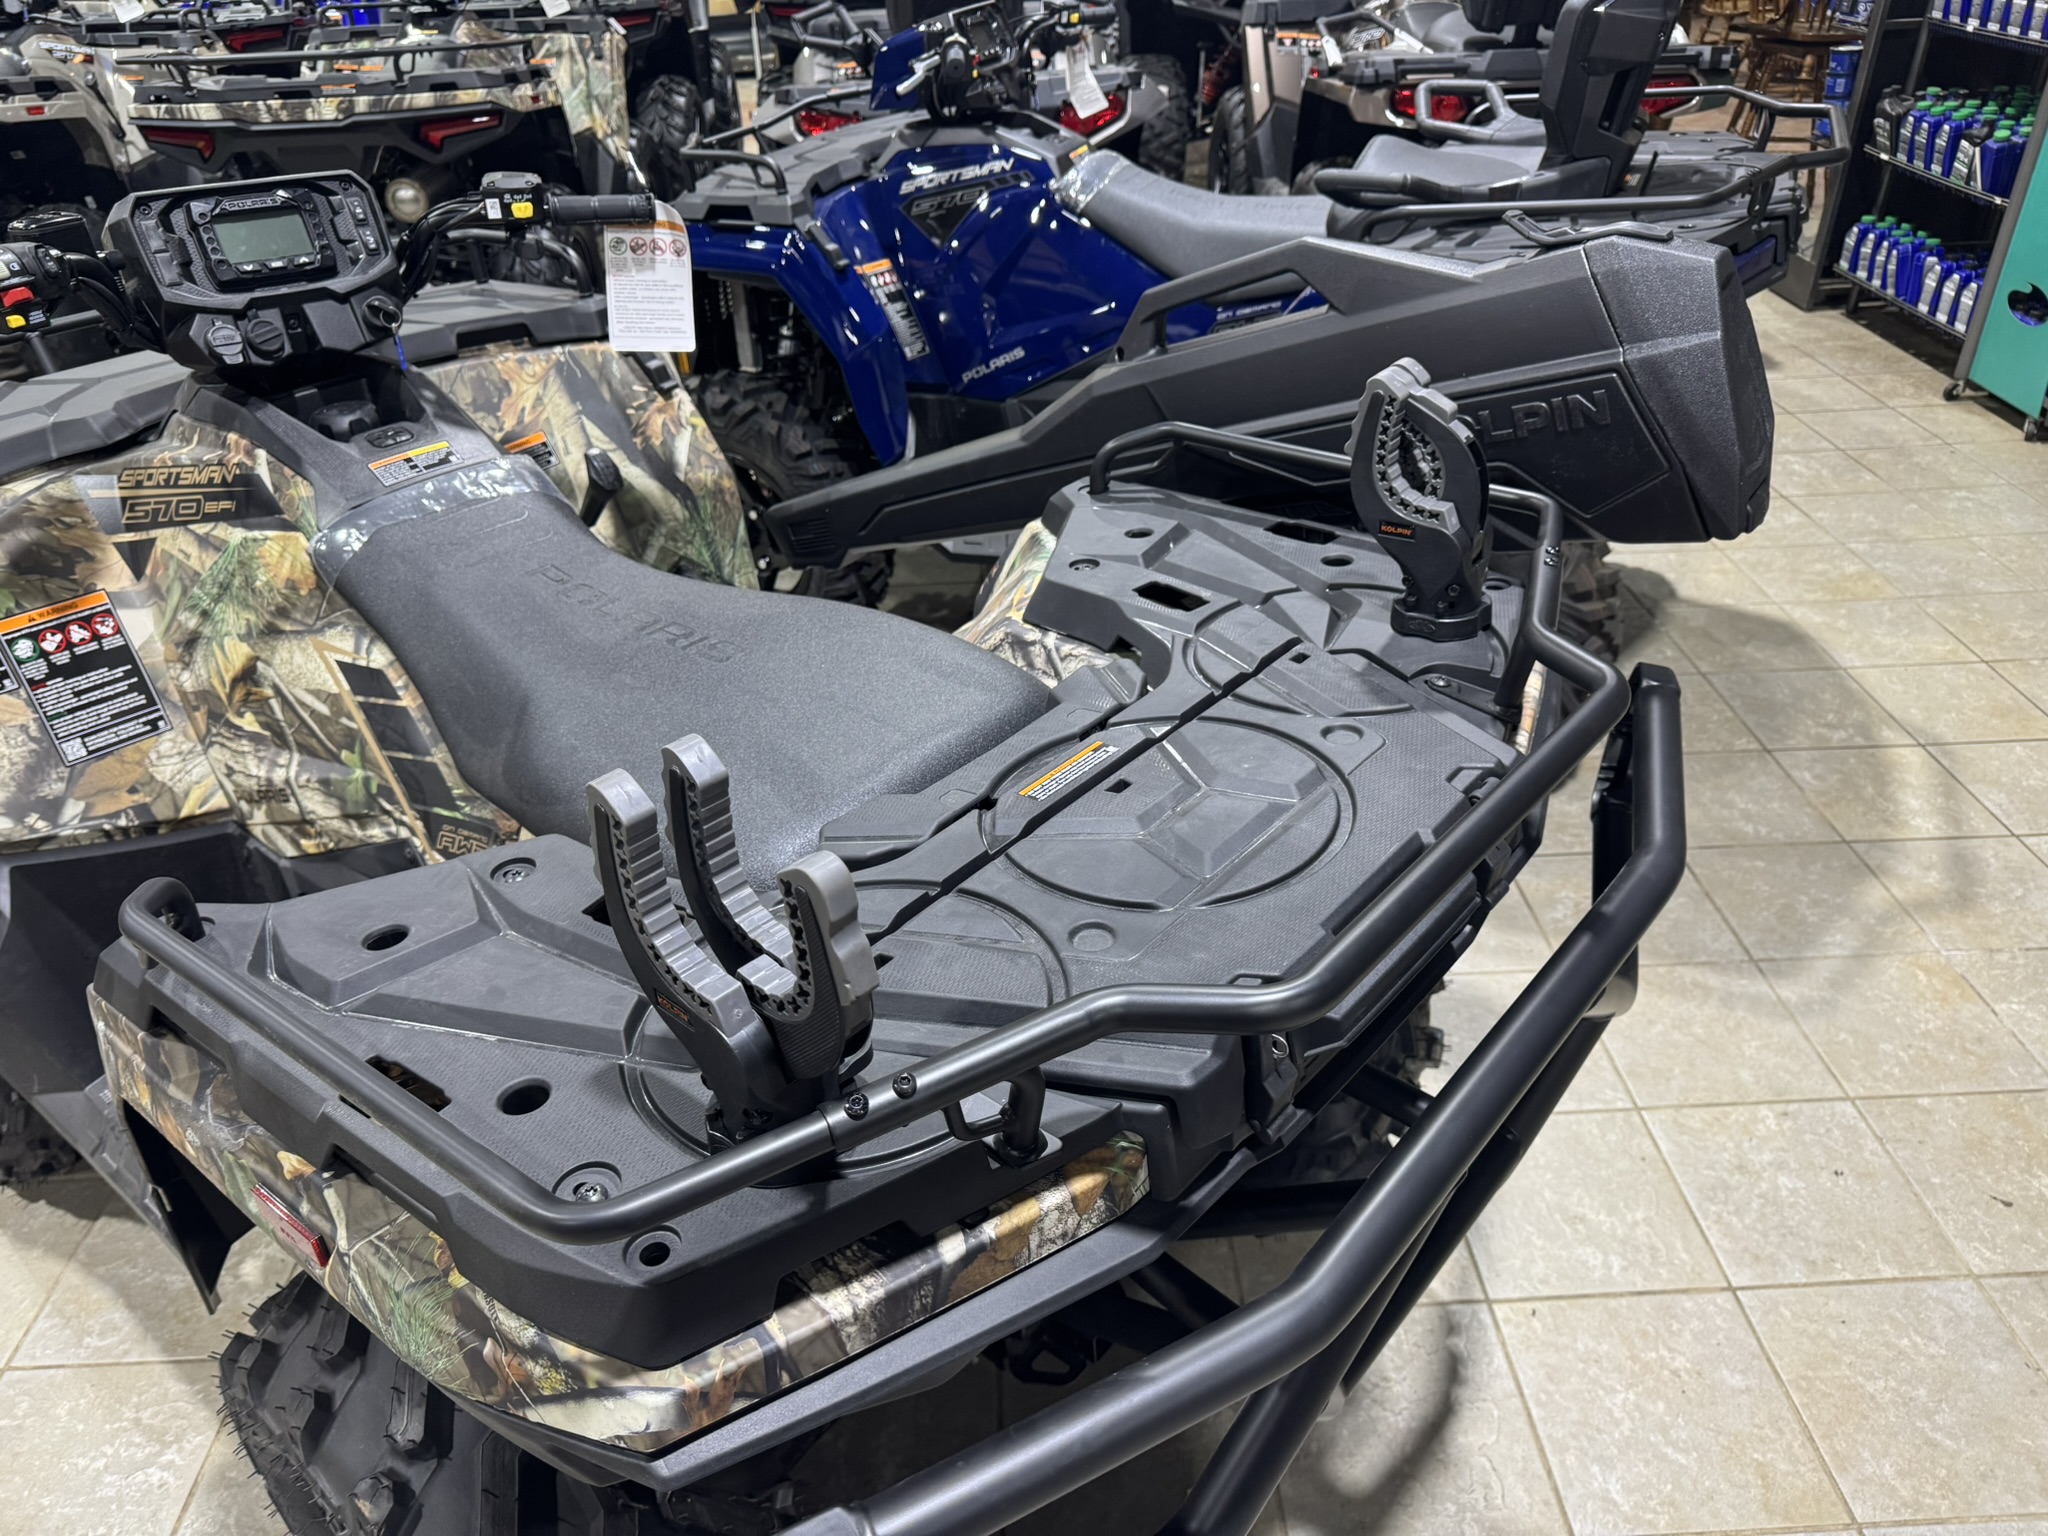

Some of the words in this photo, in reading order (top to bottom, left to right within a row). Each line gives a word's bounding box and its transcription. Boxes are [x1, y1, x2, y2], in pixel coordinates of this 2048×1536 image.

[899, 157, 1014, 195] SPORTSMAN
[227, 198, 279, 210] POLARIS
[961, 345, 1026, 384] POLARIS
[1477, 389, 1611, 443] LPIN
[117, 464, 237, 487] SPORTSMAN
[122, 494, 205, 524] 570
[204, 501, 237, 513] EFI
[1381, 525, 1412, 536] KOLPIN
[38, 603, 79, 619] WARNING
